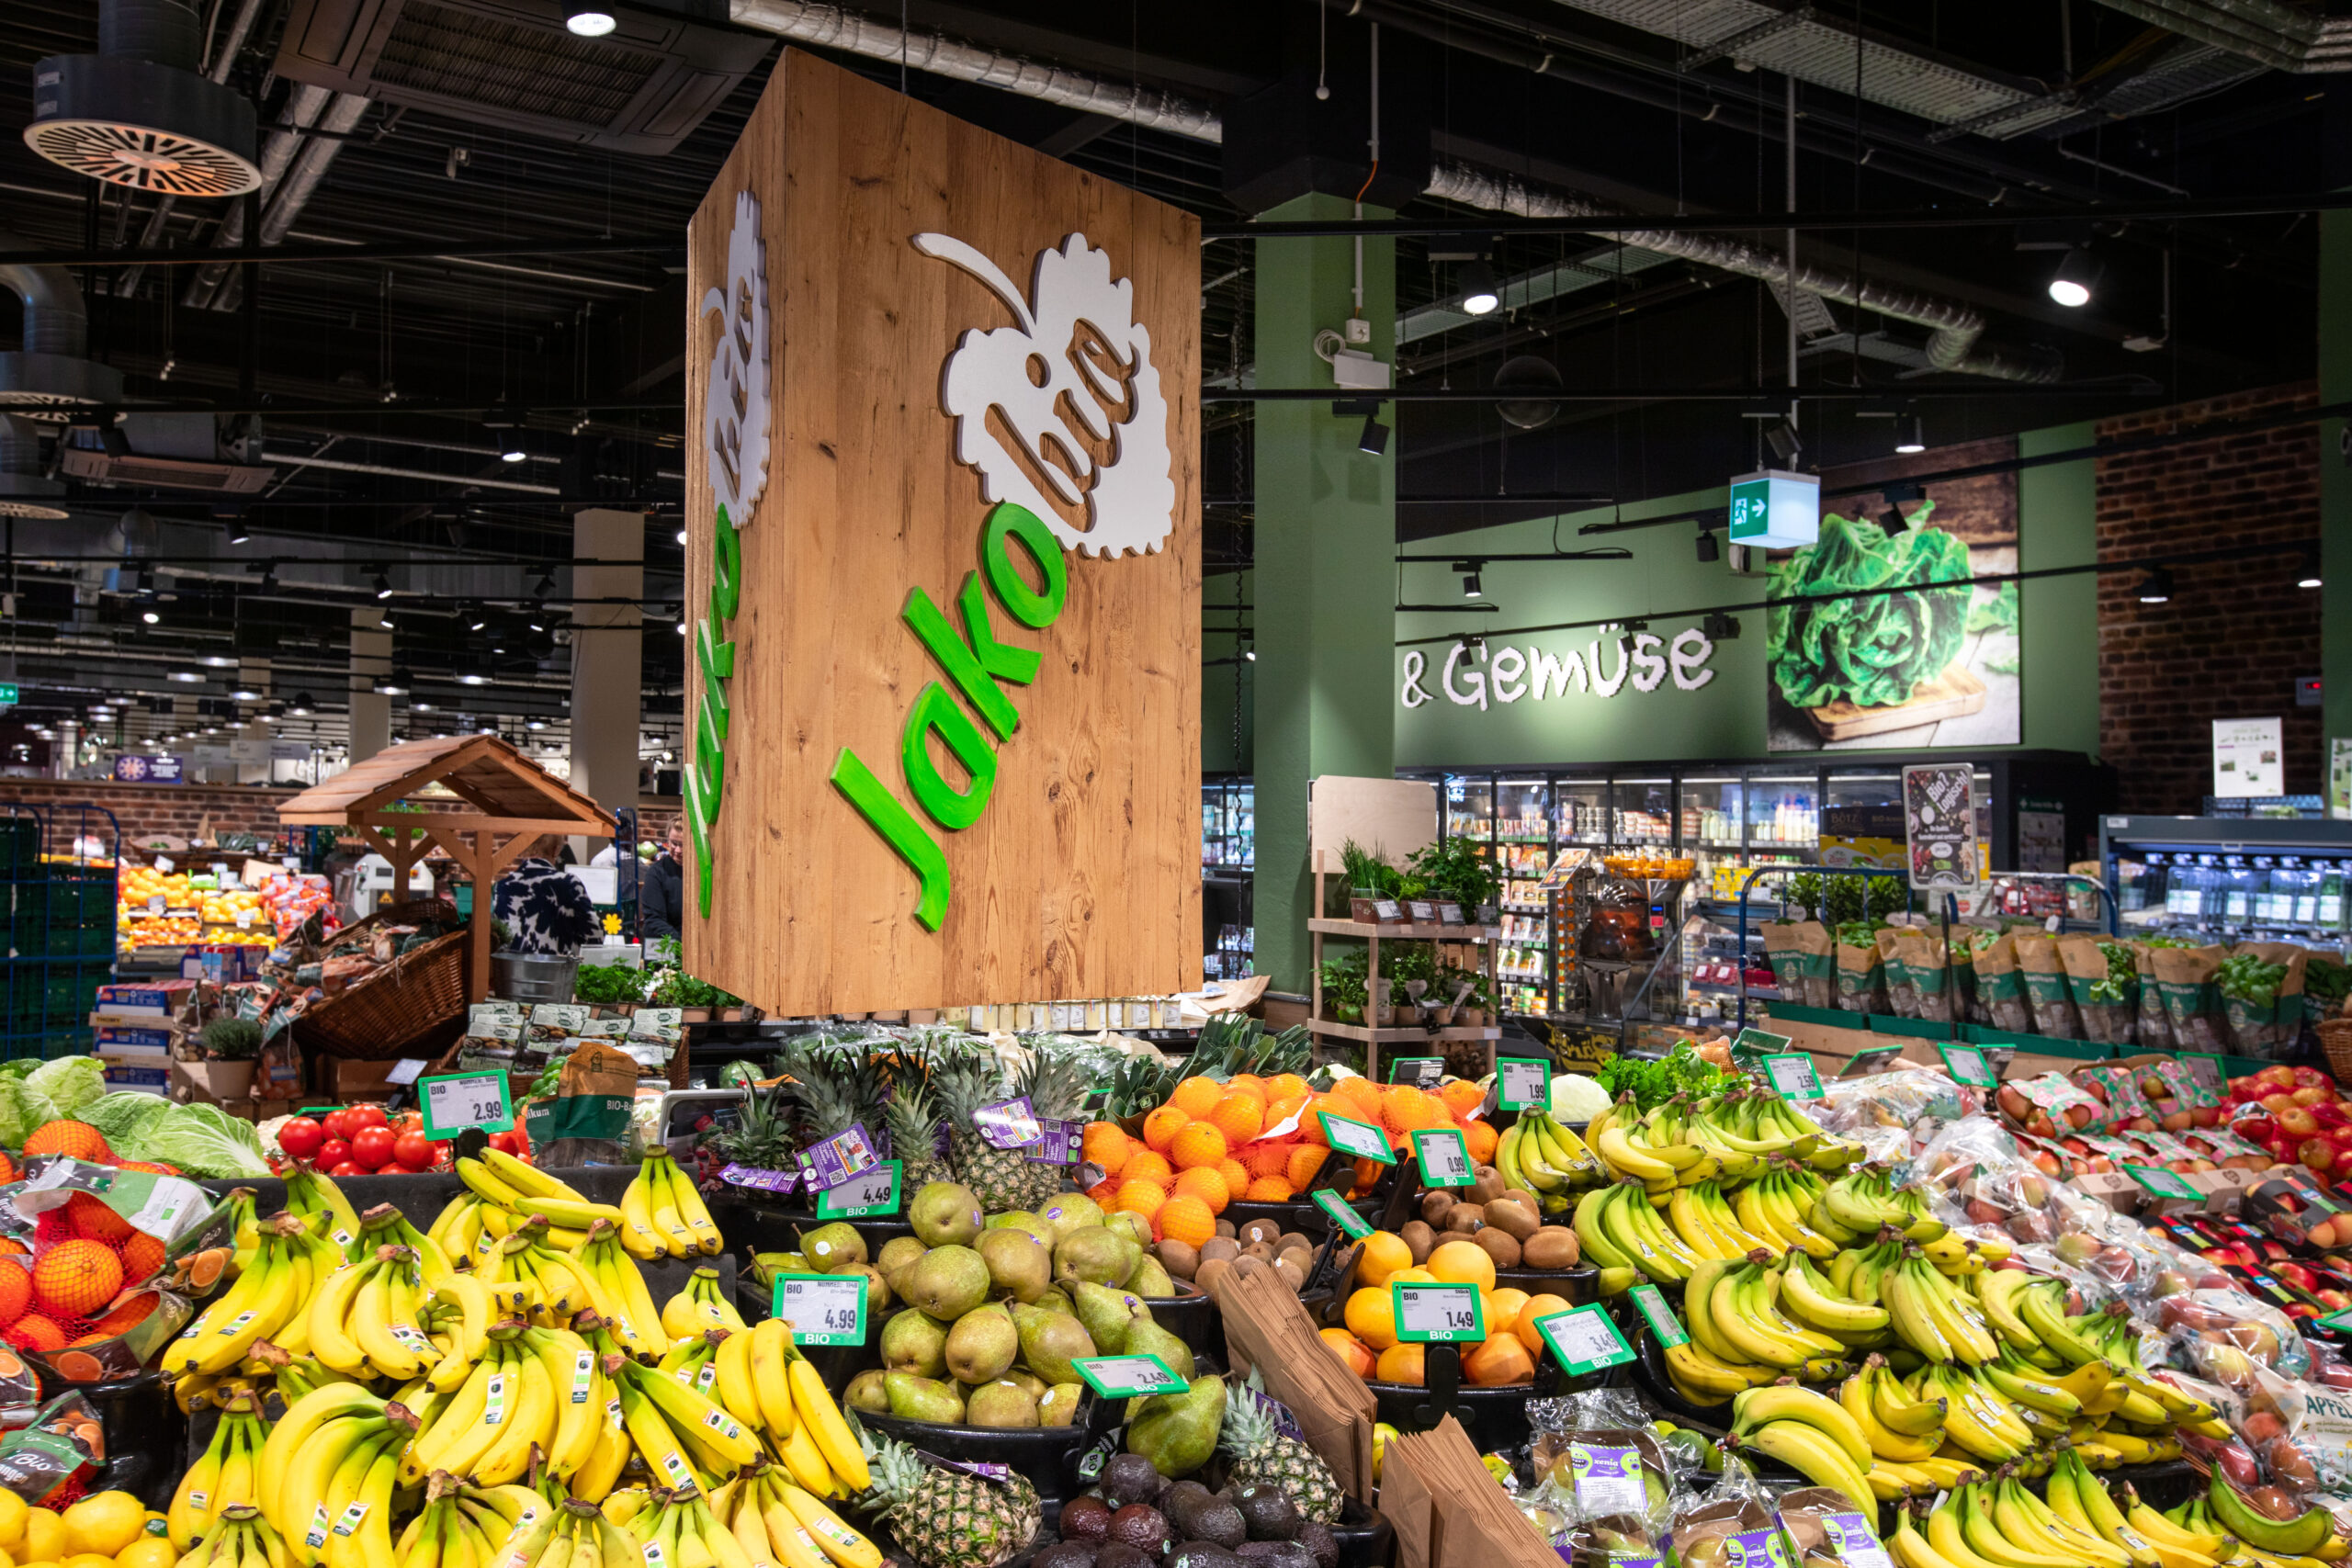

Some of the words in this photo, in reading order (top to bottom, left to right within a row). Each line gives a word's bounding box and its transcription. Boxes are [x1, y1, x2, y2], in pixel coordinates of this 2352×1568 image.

[984, 317, 1138, 534] bio
[1401, 649, 1437, 708] &
[830, 501, 1068, 932] Jako
[430, 1085, 447, 1095] BIO
[1529, 1084, 1545, 1100] 1.99
[473, 1100, 503, 1121] 2.99
[1419, 1137, 1430, 1146] BIO
[1447, 1156, 1465, 1172] 0.99
[1443, 1176, 1458, 1186] BIO
[863, 1186, 891, 1203] 4.49
[846, 1206, 868, 1216] BIO
[786, 1283, 803, 1294] BIO
[1403, 1292, 1419, 1301] BIO
[824, 1309, 856, 1329] 4.99
[1446, 1311, 1474, 1327] 1.49
[1547, 1322, 1561, 1333] BIO
[805, 1333, 831, 1345] BIO
[1430, 1330, 1453, 1340] BIO
[1589, 1333, 1620, 1353] 3.49
[1591, 1356, 1612, 1368] BIO
[1136, 1371, 1171, 1384] 2.49
[14, 1453, 52, 1472] Bio
[1593, 1458, 1619, 1468] xenia
